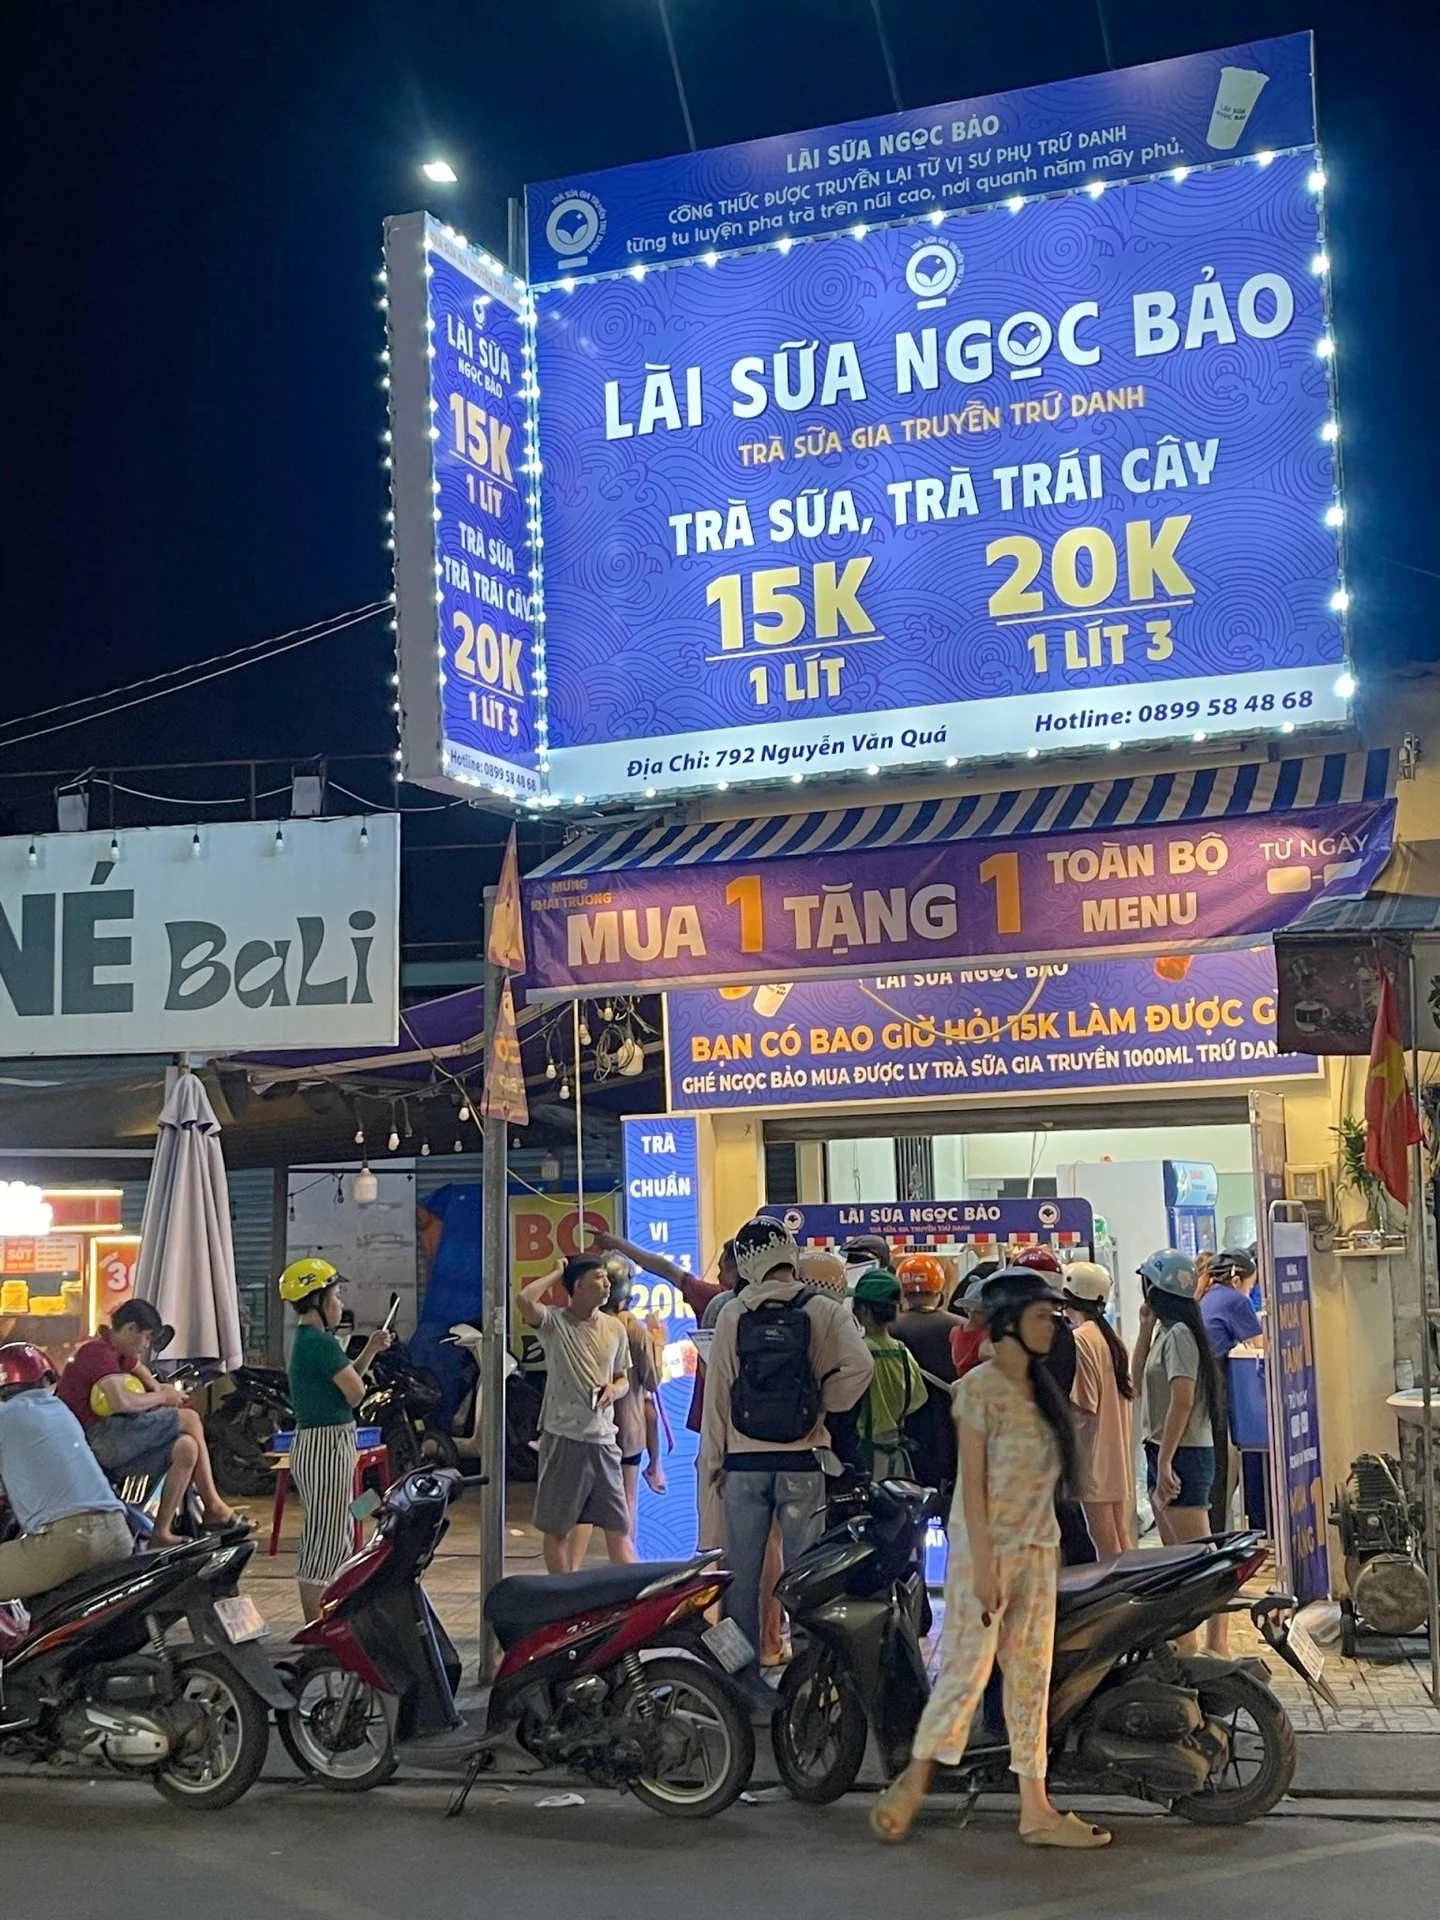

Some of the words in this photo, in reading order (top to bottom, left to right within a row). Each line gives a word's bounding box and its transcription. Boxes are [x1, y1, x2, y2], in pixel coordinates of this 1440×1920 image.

[787, 148, 819, 173] LÀI
[828, 139, 871, 165] SỮA
[879, 125, 943, 156] NGỌC
[951, 113, 999, 142] BẢO
[626, 236, 666, 255] từng
[671, 231, 690, 246] tu
[694, 222, 743, 243] luyện
[748, 215, 783, 240] pha
[788, 207, 815, 224] trà
[820, 200, 858, 220] trên
[864, 192, 892, 211] núi
[898, 188, 936, 204] cao,
[942, 180, 970, 197] nơi
[976, 166, 1037, 193] quanh
[1043, 159, 1086, 179] năm
[1092, 148, 1135, 168] mây
[1141, 137, 1184, 165] phủ.
[668, 203, 713, 224] CÔNG
[718, 192, 759, 216] THỨC
[764, 184, 811, 207] ĐƯỢC
[816, 168, 880, 197] TRUYỀN
[886, 165, 912, 186] LẠI
[917, 157, 940, 178] TỪ
[945, 156, 963, 174] VỊ
[968, 148, 991, 167] SƯ
[996, 143, 1031, 164] PHỤ
[1037, 132, 1073, 157] TRỨ
[1078, 125, 1127, 147] DANH
[447, 313, 473, 359] LÀI
[479, 337, 511, 384] SỮA
[604, 364, 702, 441] LÀI
[731, 340, 867, 421] SỮA
[895, 301, 1101, 394] NGỌC
[1132, 266, 1294, 358] BẢO
[458, 356, 483, 387] NGỌC
[484, 376, 503, 399] BẢO
[450, 392, 513, 483] 15K
[738, 436, 785, 467] TRÀ
[794, 424, 842, 460] SỮA
[851, 421, 892, 450] GIA
[901, 399, 1002, 443] TRUYỀN
[1010, 388, 1064, 429] TRỨ
[1070, 385, 1145, 416] DANH
[466, 473, 475, 505] 1
[479, 478, 502, 518] LÍT
[669, 498, 755, 556] TRÀ
[769, 489, 873, 542] SỮA,
[887, 466, 980, 526] TRÀ
[998, 448, 1103, 511] TRÁI
[1122, 434, 1221, 493] CÂY
[458, 521, 486, 560] TRÀ
[488, 538, 515, 575] SỮA
[985, 513, 1197, 618] 20K
[443, 554, 471, 594] TRÀ
[473, 570, 503, 610] TRÁI
[507, 587, 532, 622] CÂY
[706, 556, 877, 652] 15K
[453, 611, 524, 697] 20K
[1027, 632, 1048, 674] 1
[1065, 619, 1130, 671] LÍT
[1147, 620, 1173, 663] 3
[749, 666, 769, 706] 1
[784, 652, 846, 703] LÍT
[469, 691, 477, 721] 1
[482, 694, 503, 732] LÍT
[508, 706, 518, 737] 3
[1035, 710, 1132, 733] Hotline:
[1138, 701, 1200, 723] 0899
[1207, 698, 1237, 717] 58
[1244, 694, 1275, 713] 48
[1282, 690, 1314, 710] 68
[451, 749, 483, 774] Hotline:
[484, 762, 504, 780] 0899
[506, 770, 515, 785] 58
[516, 773, 526, 788] 48
[527, 777, 536, 792] 68
[627, 757, 662, 782] Địa
[669, 750, 710, 773] Chỉ:
[716, 747, 755, 768] 792
[760, 734, 846, 766] Nguyễn
[852, 732, 893, 753] Văn
[900, 725, 947, 747] Quá
[1047, 842, 1153, 884] TOÀN
[1169, 831, 1228, 876] BỘ
[1259, 837, 1293, 861] TỪ
[1300, 831, 1368, 858] NGÀY
[567, 905, 707, 967] MUA
[726, 874, 764, 954] 1
[784, 881, 958, 955] TẶNG
[979, 852, 1021, 934] 1
[1082, 892, 1197, 933] MENU
[691, 1032, 752, 1067] BẠN
[760, 1024, 801, 1058] CÓ
[810, 1025, 874, 1055] BAO
[882, 1014, 937, 1049] GIỜ
[945, 1007, 1000, 1045] HỎI
[1007, 1011, 1060, 1042] 15K
[1068, 1002, 1135, 1039] LÀM
[1145, 996, 1243, 1036] ĐƯỢC
[682, 1071, 716, 1094] GHÉ
[720, 1072, 767, 1094] NGỌC
[771, 1065, 807, 1088] BẢO
[812, 1067, 850, 1087] MUA
[854, 1061, 904, 1086] ĐƯỢC
[909, 1062, 930, 1080] LY
[932, 1056, 967, 1078] TRÀ
[971, 1053, 1007, 1076] SỮA
[1012, 1054, 1044, 1074] GIA
[1047, 1044, 1121, 1071] TRUYỀN
[1124, 1046, 1193, 1067] 1000ML
[1197, 1038, 1238, 1062] TRỨ
[641, 1133, 676, 1154] TRÀ
[630, 1171, 691, 1198] CHUẨN
[649, 1222, 668, 1243] VỊ
[839, 1207, 864, 1224] LÀI
[870, 1207, 904, 1223] SỮA
[910, 1207, 958, 1222] NGỌC
[964, 1203, 1001, 1220] BẢO
